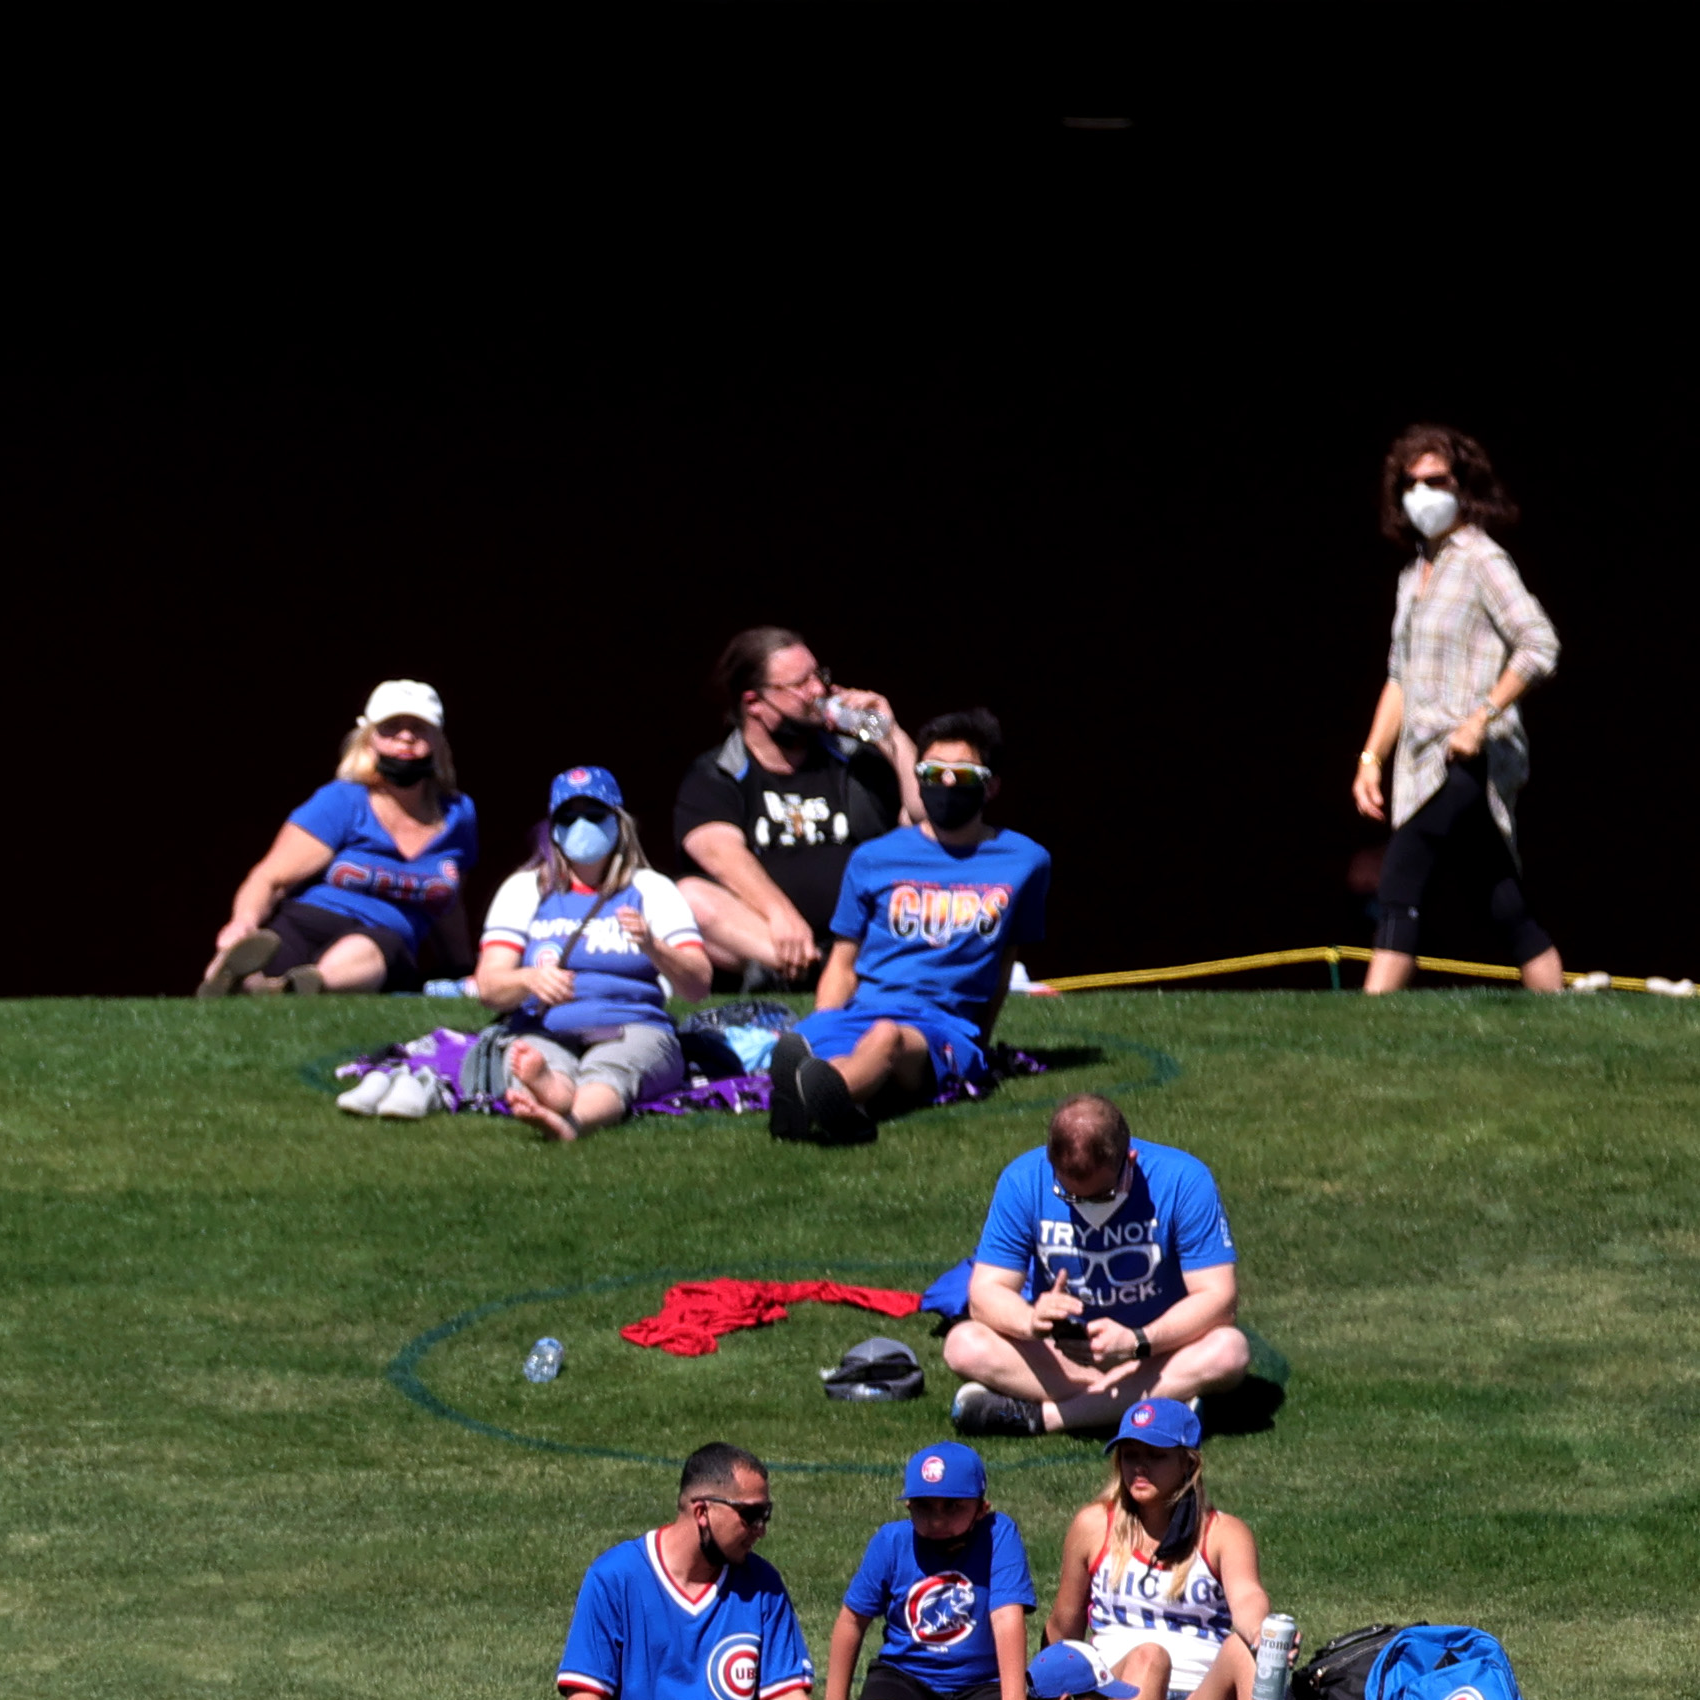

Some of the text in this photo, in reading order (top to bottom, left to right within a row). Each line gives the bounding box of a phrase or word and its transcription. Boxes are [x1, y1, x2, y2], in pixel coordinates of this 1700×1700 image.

[1040, 1218, 1159, 1245] TRY NOT
[723, 1649, 758, 1696] CUB
